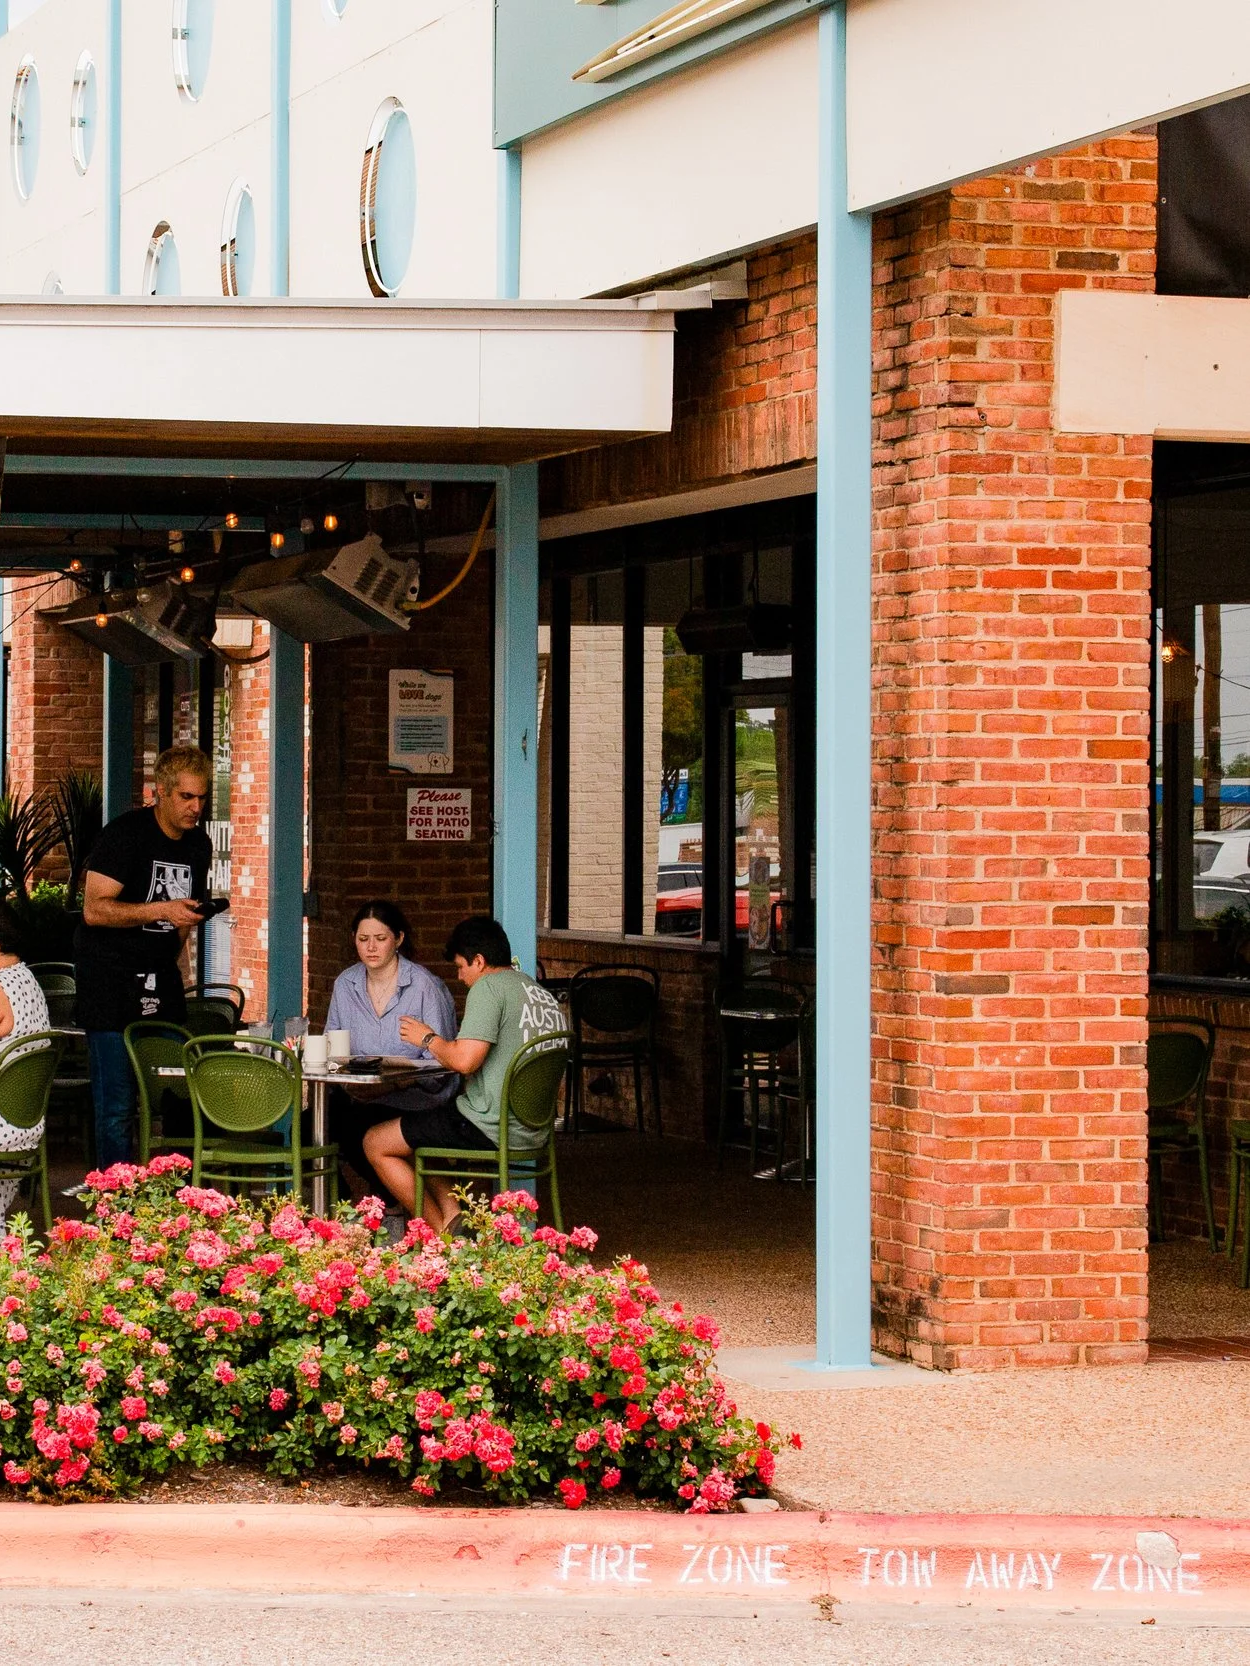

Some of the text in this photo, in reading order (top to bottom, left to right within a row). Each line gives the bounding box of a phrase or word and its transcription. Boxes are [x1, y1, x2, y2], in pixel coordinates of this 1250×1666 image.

[399, 689, 424, 700] LOVE
[417, 789, 462, 804] Please
[410, 806, 468, 815] SEE HOST
[409, 817, 469, 827] FOR PATIO
[206, 821, 231, 851] WIT
[415, 829, 464, 838] SEATING
[207, 860, 231, 890] HAI
[561, 1543, 1203, 1595] FIRE ZONE TOW AWAY ZONE
